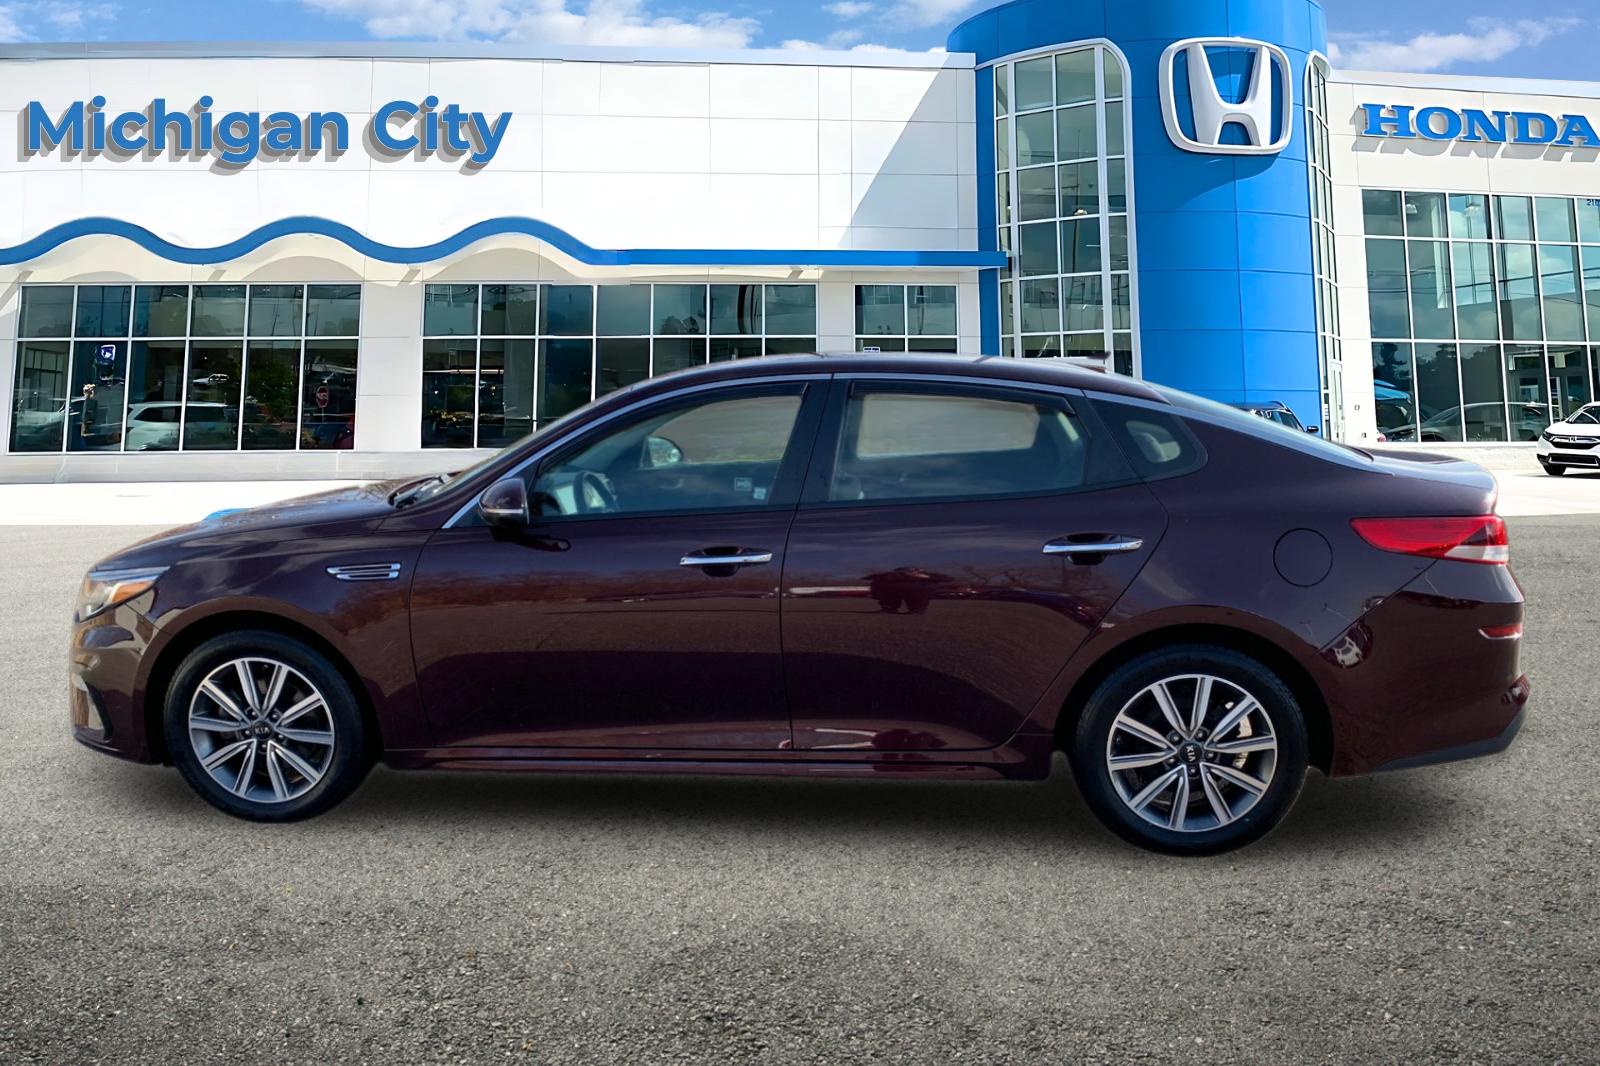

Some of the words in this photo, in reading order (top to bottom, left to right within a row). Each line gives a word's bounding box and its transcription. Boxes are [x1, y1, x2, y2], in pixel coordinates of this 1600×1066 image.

[26, 95, 349, 164] Michigan
[373, 95, 513, 164] City
[1361, 103, 1600, 147] HONDA
[254, 727, 270, 735] KIA
